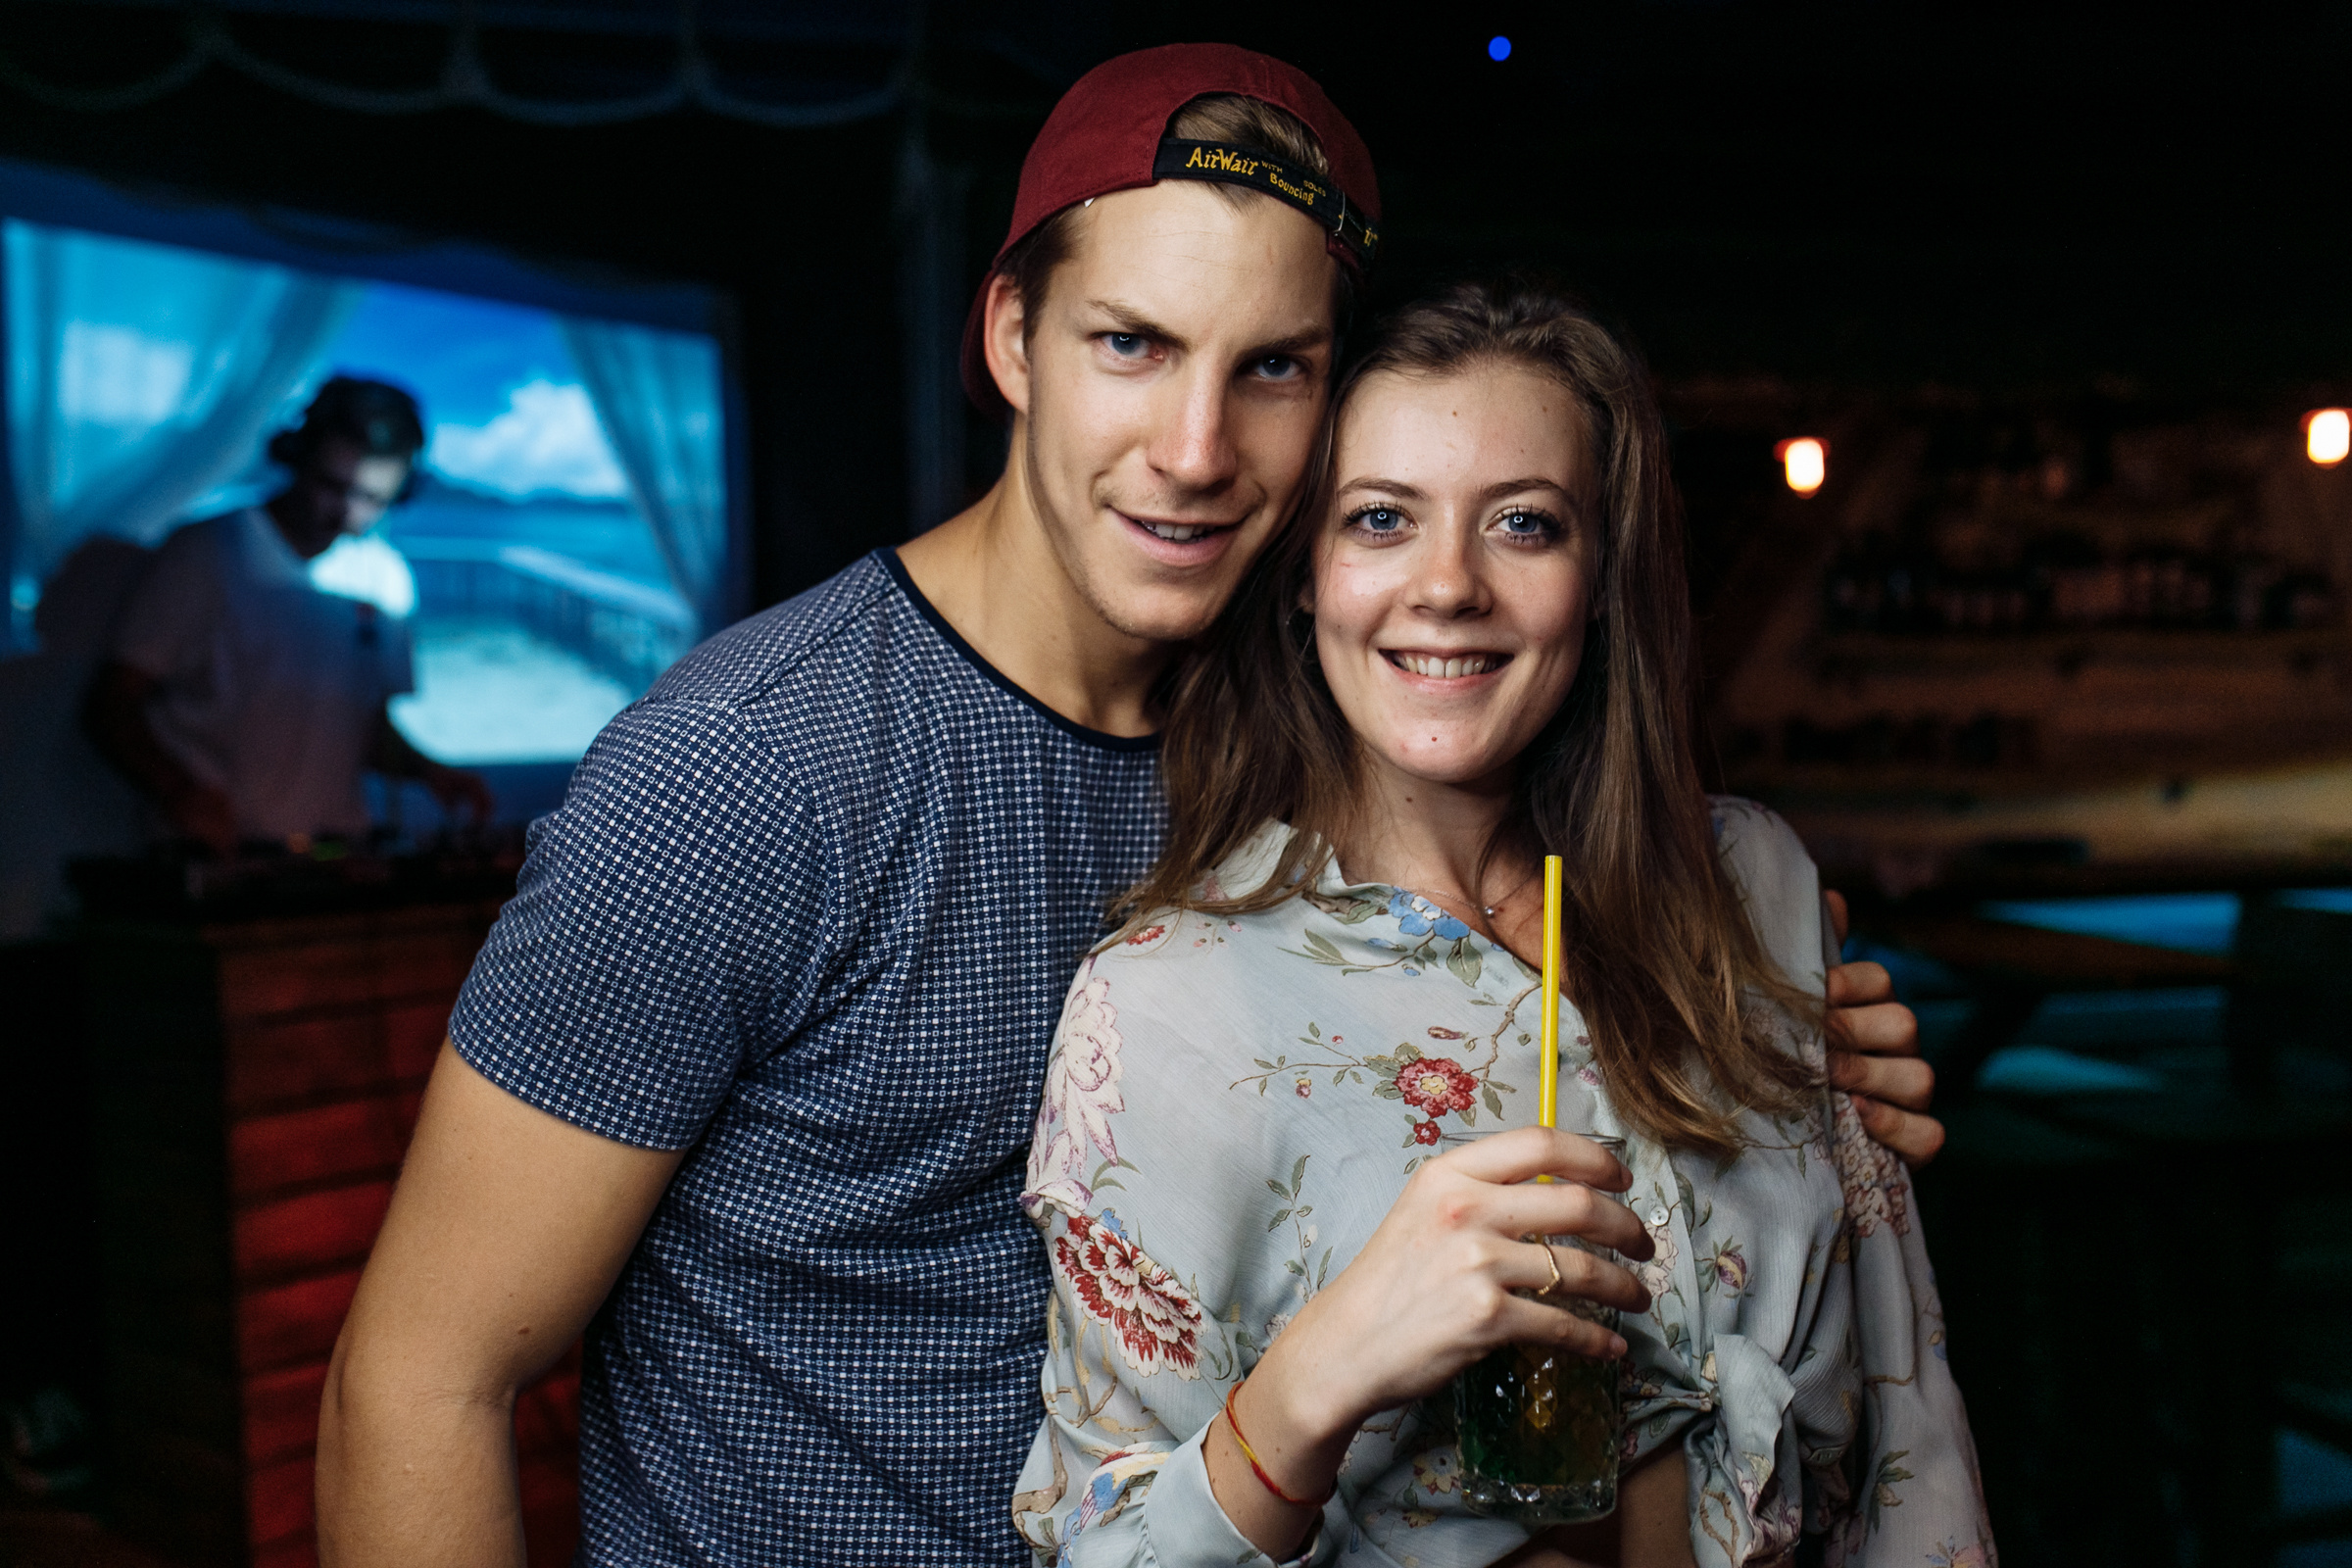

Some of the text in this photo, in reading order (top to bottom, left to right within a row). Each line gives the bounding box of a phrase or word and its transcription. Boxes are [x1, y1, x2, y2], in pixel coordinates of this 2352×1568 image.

[1186, 147, 1258, 175] AirWair
[1261, 160, 1283, 173] WITH
[1269, 172, 1314, 206] Bouncing
